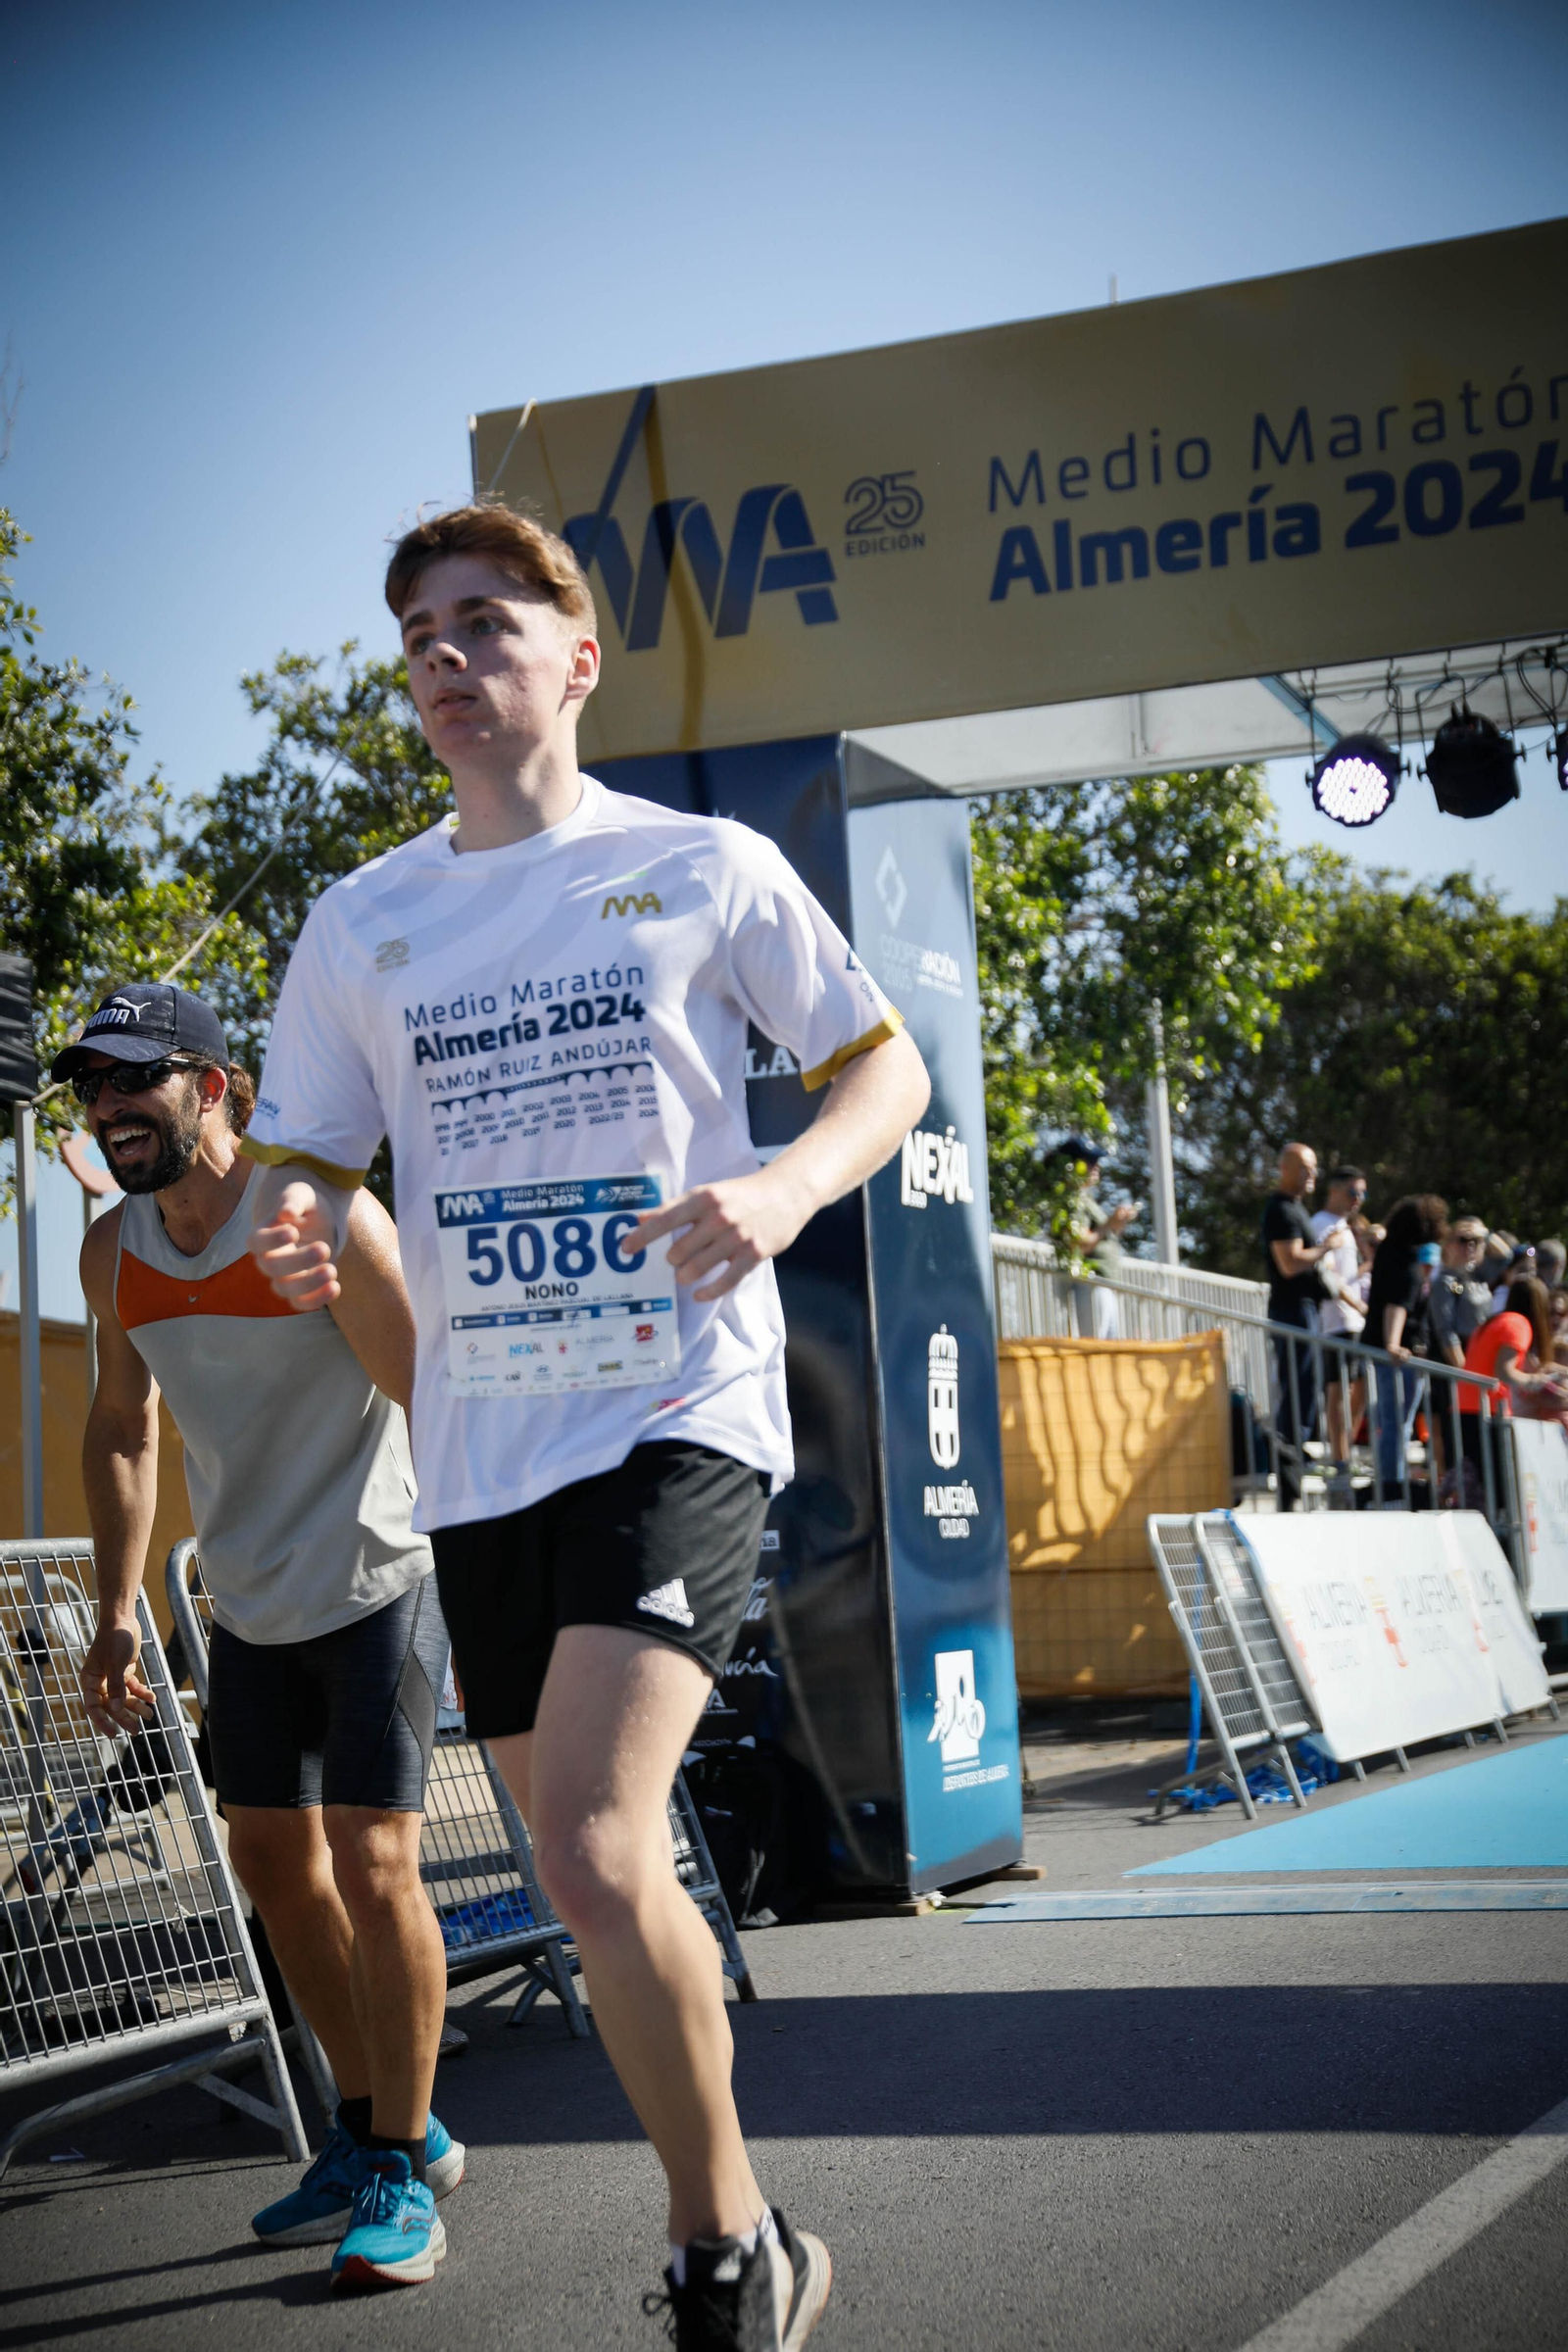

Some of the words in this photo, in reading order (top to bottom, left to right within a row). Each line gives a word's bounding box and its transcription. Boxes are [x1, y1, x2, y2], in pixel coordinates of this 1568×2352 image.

[988, 428, 1211, 514] Medio
[843, 470, 924, 536] 25
[988, 483, 1321, 603] Almería
[1344, 439, 1568, 550] 2024
[846, 531, 926, 557] EDICIÓN
[376, 936, 410, 963] 25
[405, 992, 498, 1031] Medio
[511, 962, 644, 1007] Maratón
[87, 1008, 130, 1028] UMA
[414, 1011, 542, 1066] Almería
[546, 992, 647, 1036] 2024
[425, 1065, 491, 1094] RAMÓN
[500, 1054, 542, 1078] RUIZ
[551, 1036, 653, 1067] ANDÚJAR
[745, 1046, 799, 1080] LA
[550, 1094, 572, 1105] 2003
[578, 1091, 600, 1101] 2004
[607, 1085, 629, 1097] 2005
[502, 1187, 534, 1200] Medio
[537, 1183, 584, 1196] Maratón
[502, 1195, 549, 1212] Almería
[551, 1193, 586, 1207] 2024
[466, 1212, 648, 1287] 5086
[524, 1281, 580, 1300] NONO
[924, 1479, 979, 1517] ALMERÍA
[637, 1595, 695, 1629] adidas
